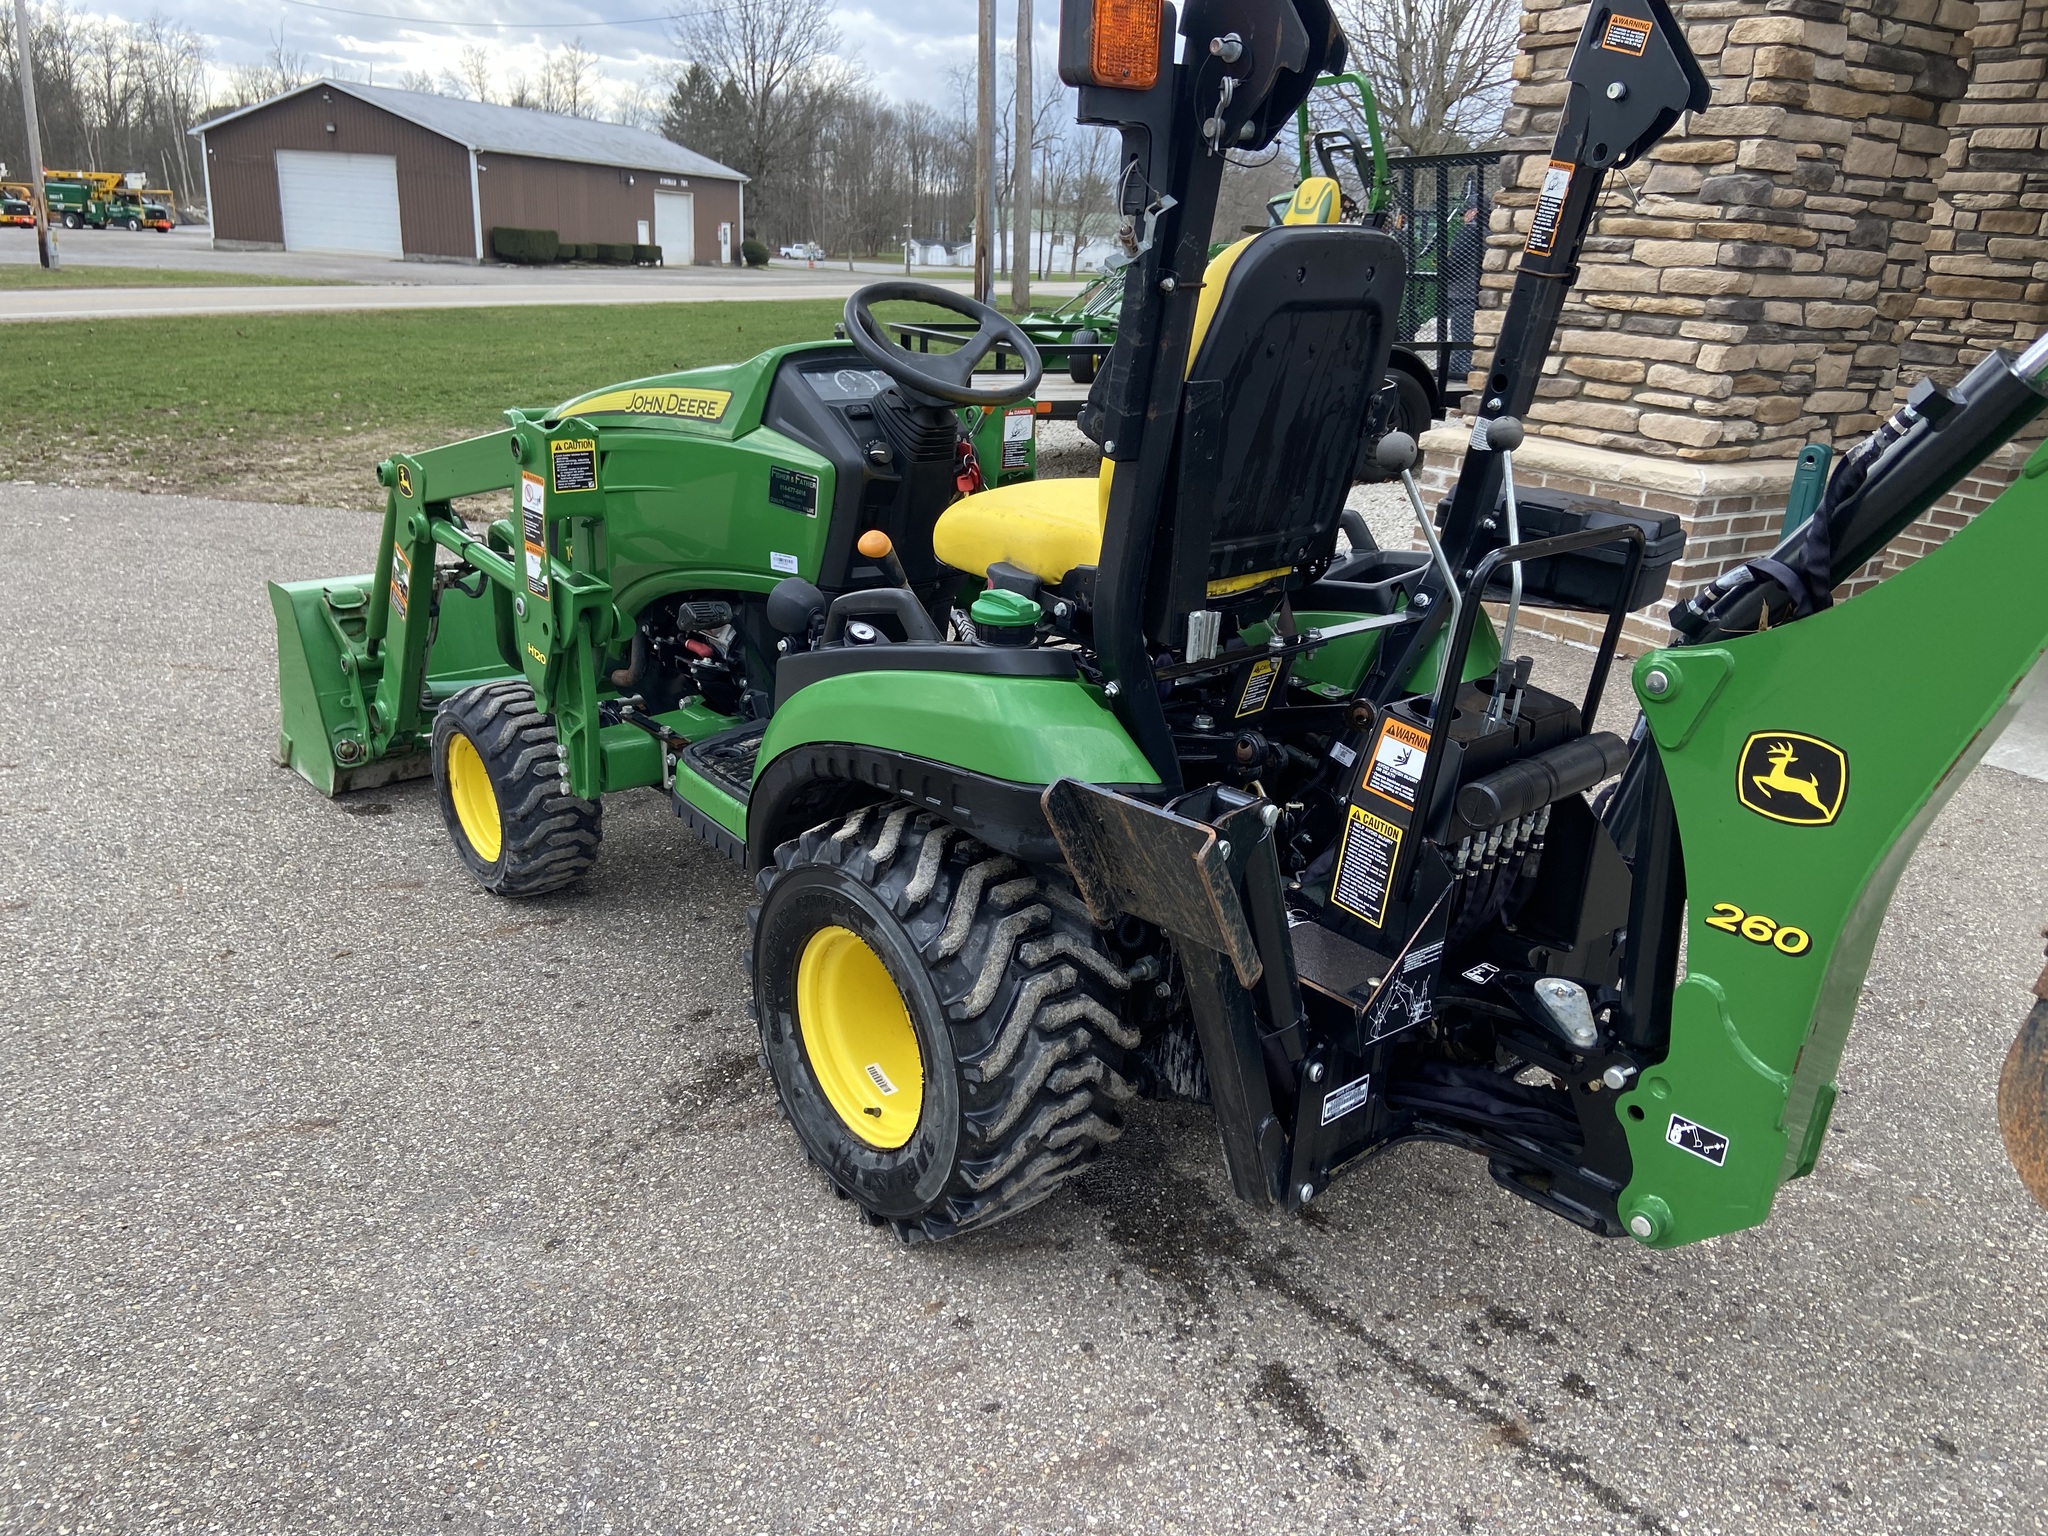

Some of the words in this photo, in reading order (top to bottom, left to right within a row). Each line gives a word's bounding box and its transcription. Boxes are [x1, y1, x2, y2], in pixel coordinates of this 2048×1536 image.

[1618, 17, 1650, 30] WARNING
[625, 393, 664, 411] JOHN
[666, 394, 718, 417] DEERE
[564, 441, 593, 450] CAUTION
[771, 468, 791, 481] FISHER
[795, 474, 817, 489] FATHER
[1396, 726, 1429, 750] WARNIN
[1363, 813, 1399, 840] CAUTION
[1705, 902, 1812, 956] 260
